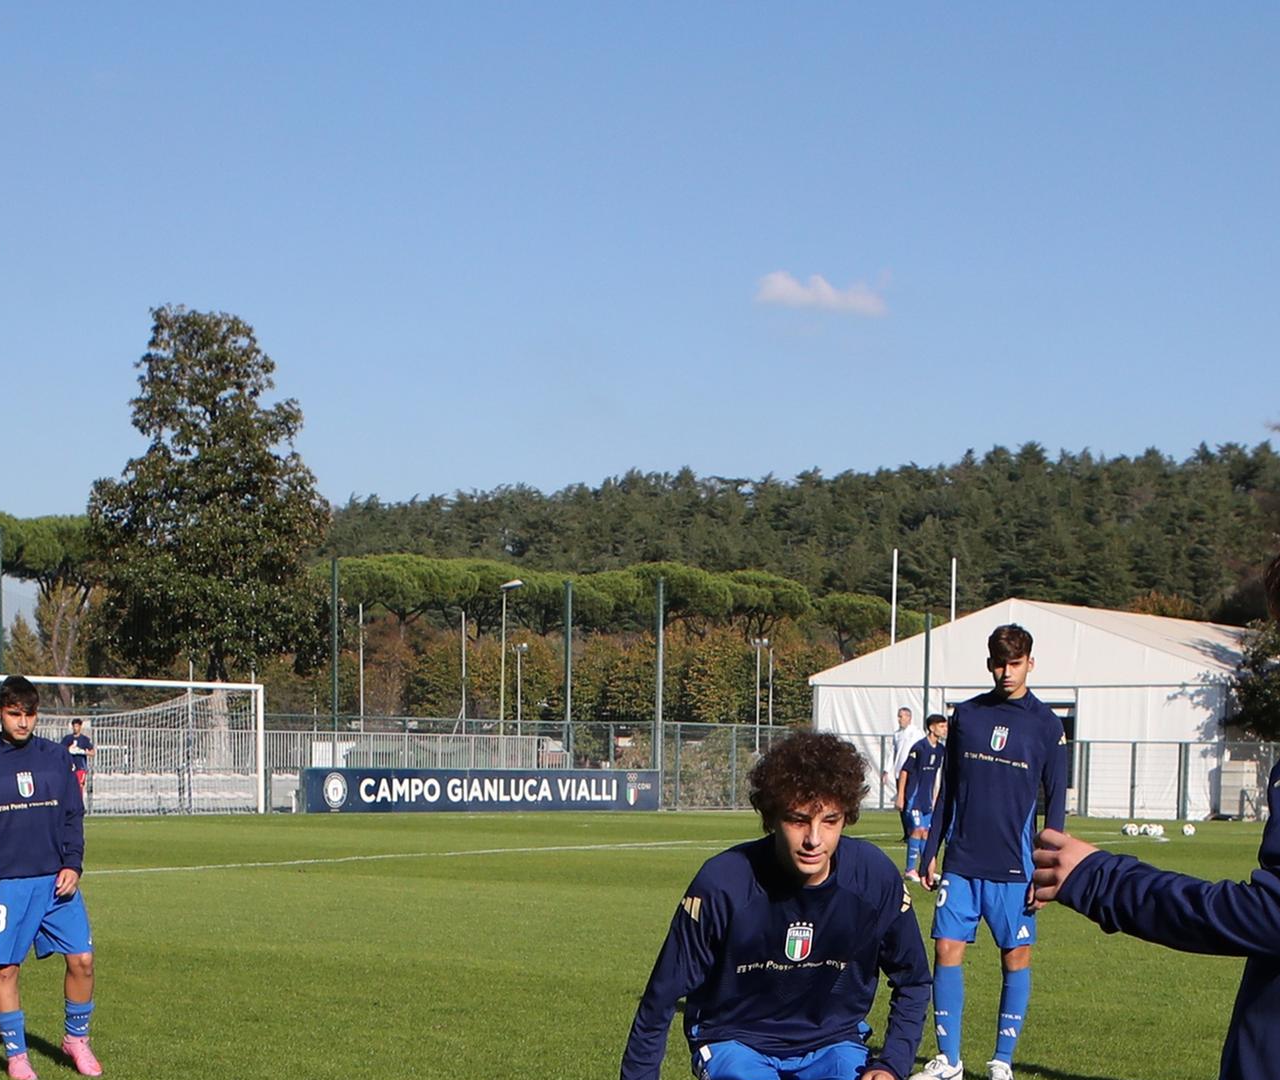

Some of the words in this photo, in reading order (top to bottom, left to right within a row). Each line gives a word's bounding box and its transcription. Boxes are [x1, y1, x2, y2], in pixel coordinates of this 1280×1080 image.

[360, 778, 441, 803] CAMPO
[447, 778, 552, 803] GIANLUCA
[558, 778, 618, 801] VIALLI
